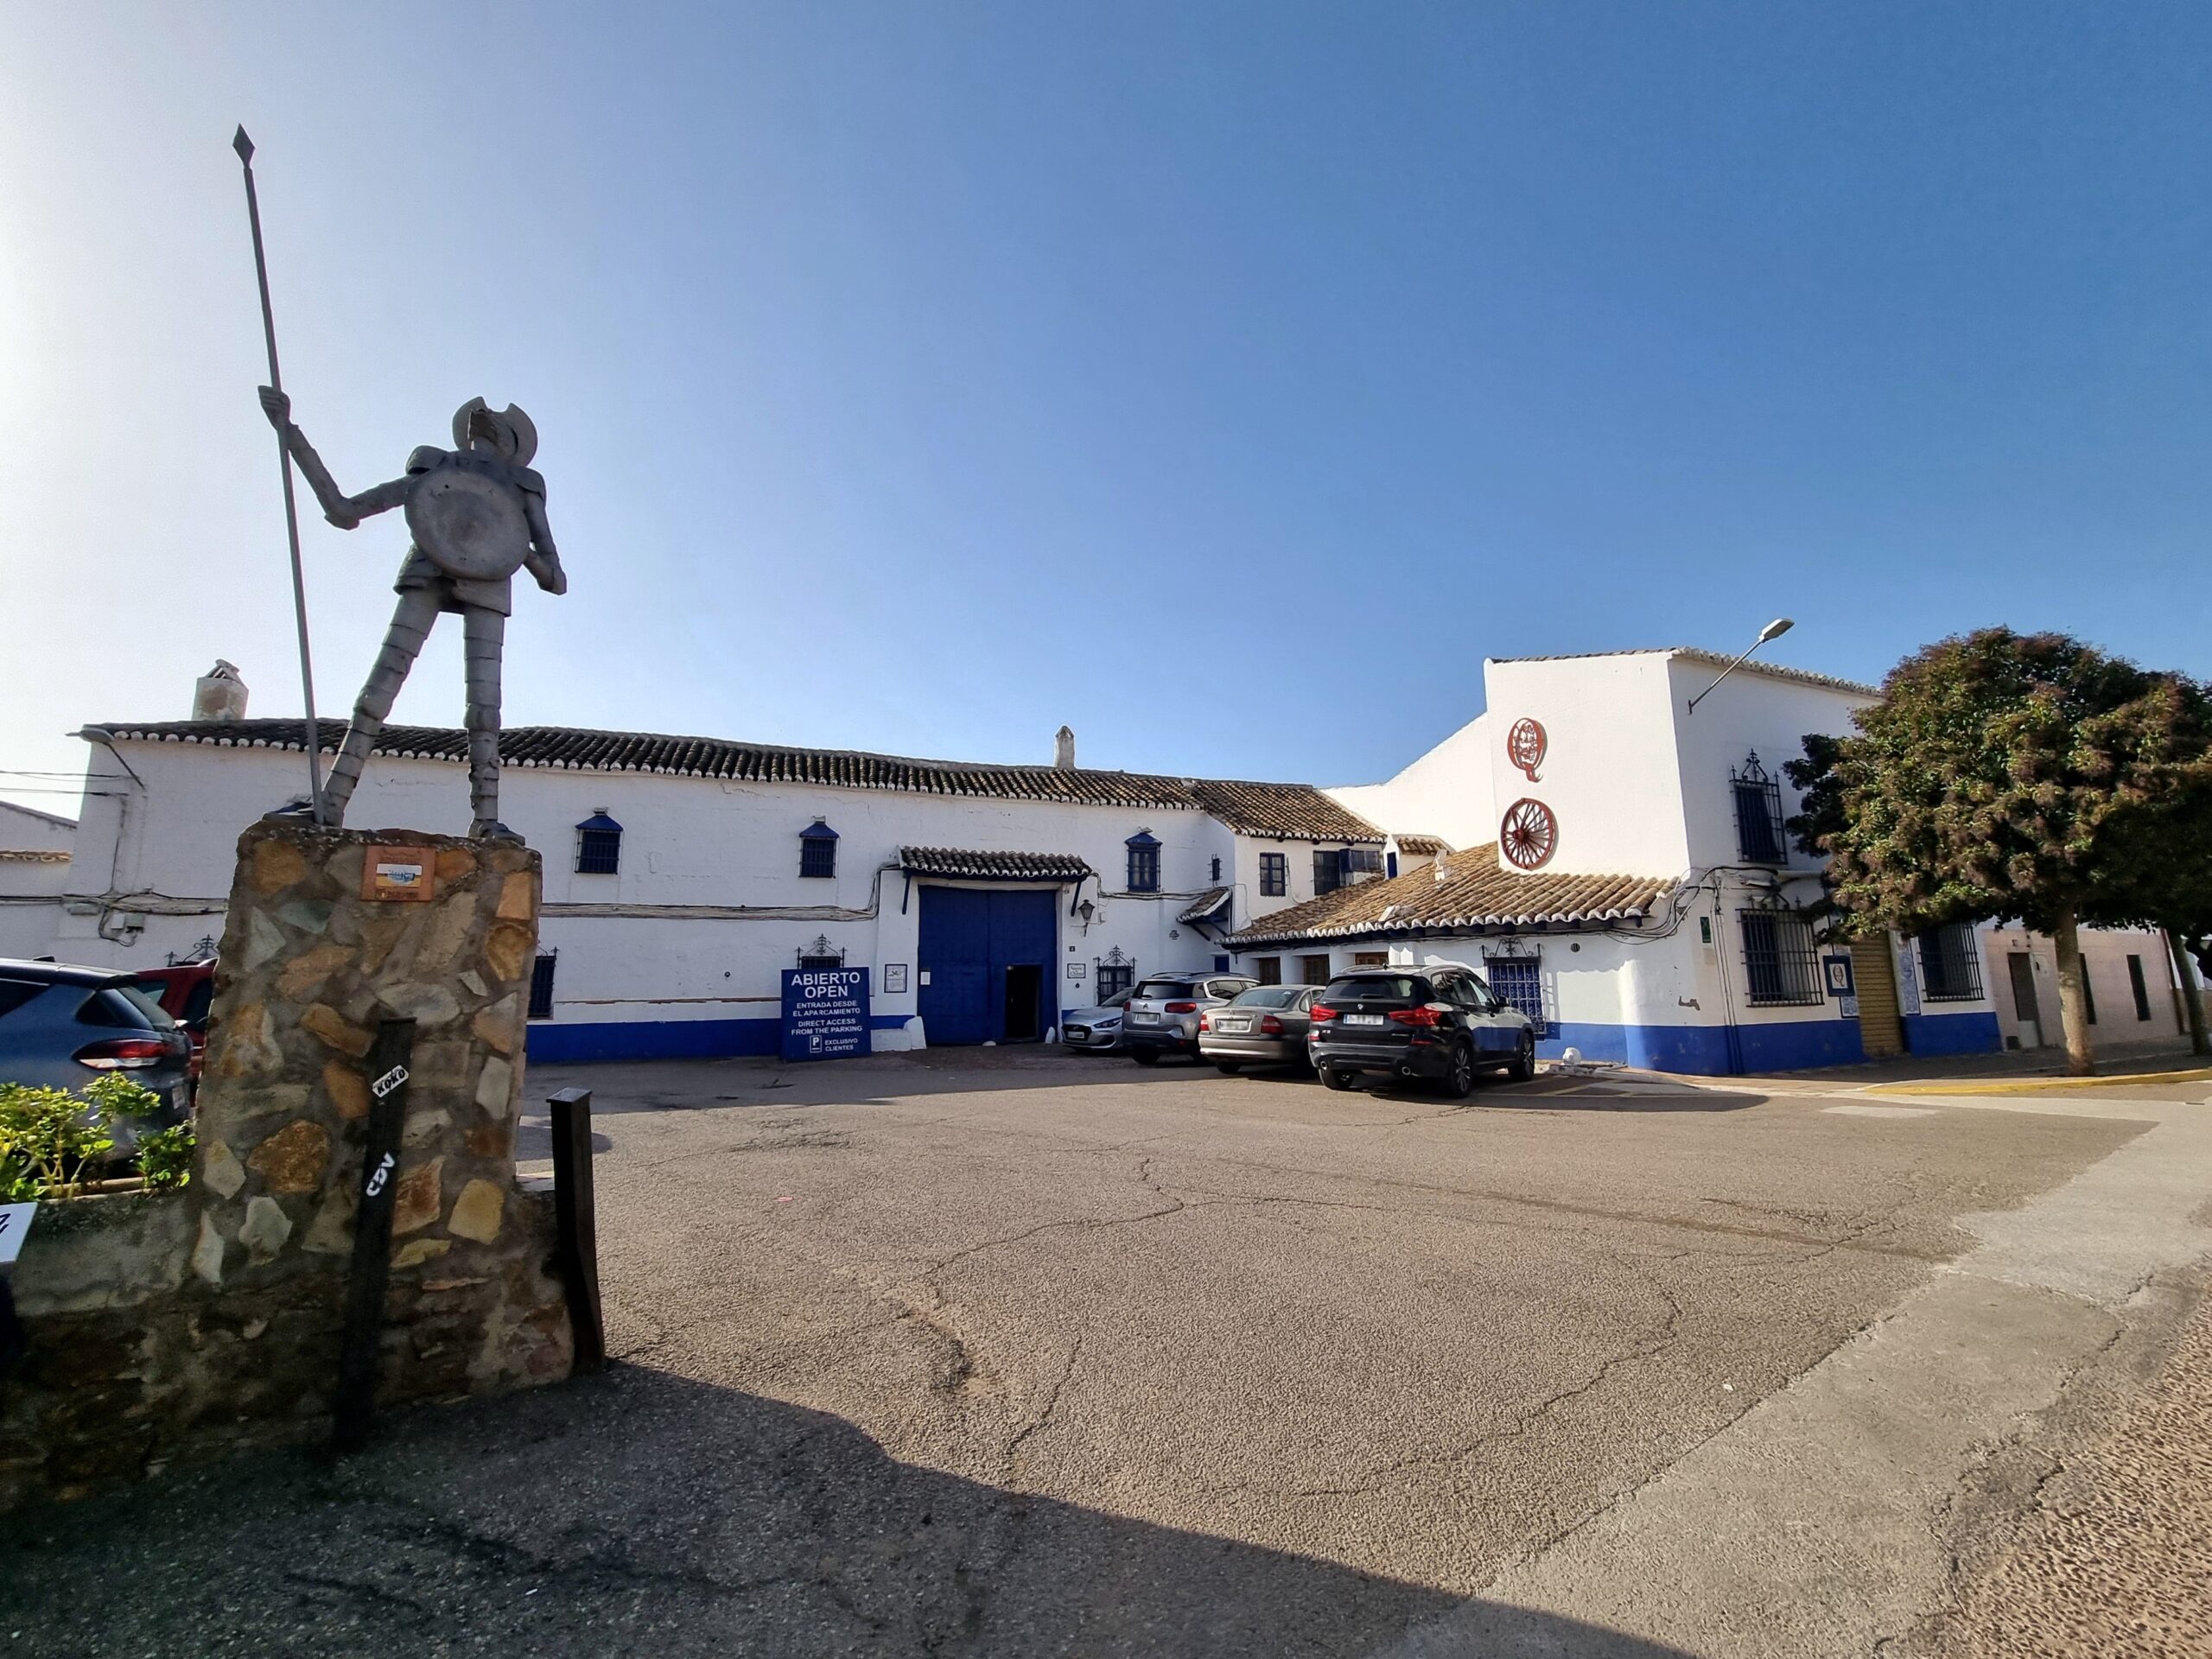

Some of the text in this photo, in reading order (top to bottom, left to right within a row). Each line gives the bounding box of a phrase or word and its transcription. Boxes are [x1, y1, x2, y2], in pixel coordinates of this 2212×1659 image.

[791, 971, 861, 986] ABIERTO
[804, 985, 848, 999] OPEN
[804, 1007, 861, 1016] APARCAMIENTO
[830, 1025, 863, 1033] PARKING
[812, 1037, 820, 1046] P
[377, 1068, 406, 1095] KOKO
